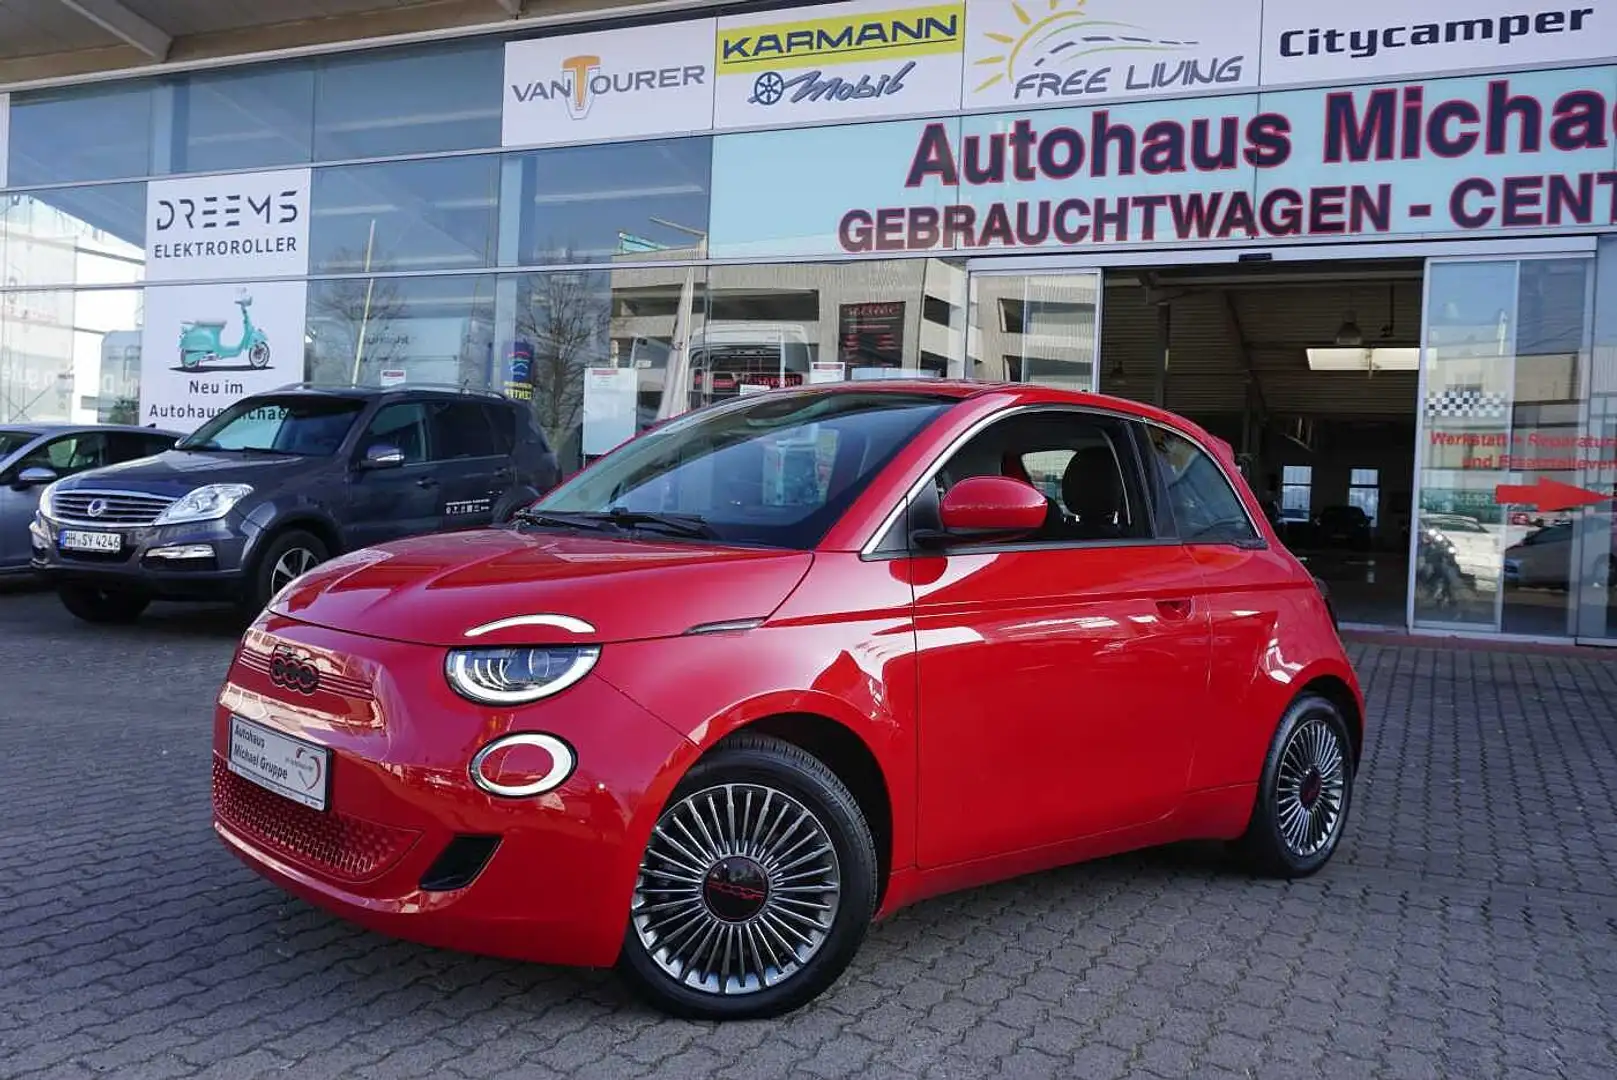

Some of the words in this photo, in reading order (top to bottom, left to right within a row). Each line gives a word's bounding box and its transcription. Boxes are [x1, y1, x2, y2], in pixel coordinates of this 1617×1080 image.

[723, 14, 957, 60] KARMANN
[1279, 8, 1594, 58] Citycamper
[784, 61, 916, 103] Mobil
[1014, 67, 1111, 99] FREE
[1126, 55, 1244, 90] LIVING
[904, 109, 1293, 188] Autohaus
[1323, 80, 1617, 163] Micha
[157, 190, 298, 231] DREEMS
[838, 183, 1392, 253] GEBRAUCHTWAGEN
[154, 237, 297, 259] ELEKTROROLLER
[189, 379, 220, 394] Neu
[225, 380, 243, 393] im
[1462, 455, 1493, 469] und
[234, 723, 265, 749] Autohaus
[233, 743, 259, 768] Michael
[260, 757, 288, 780] Gruppe
